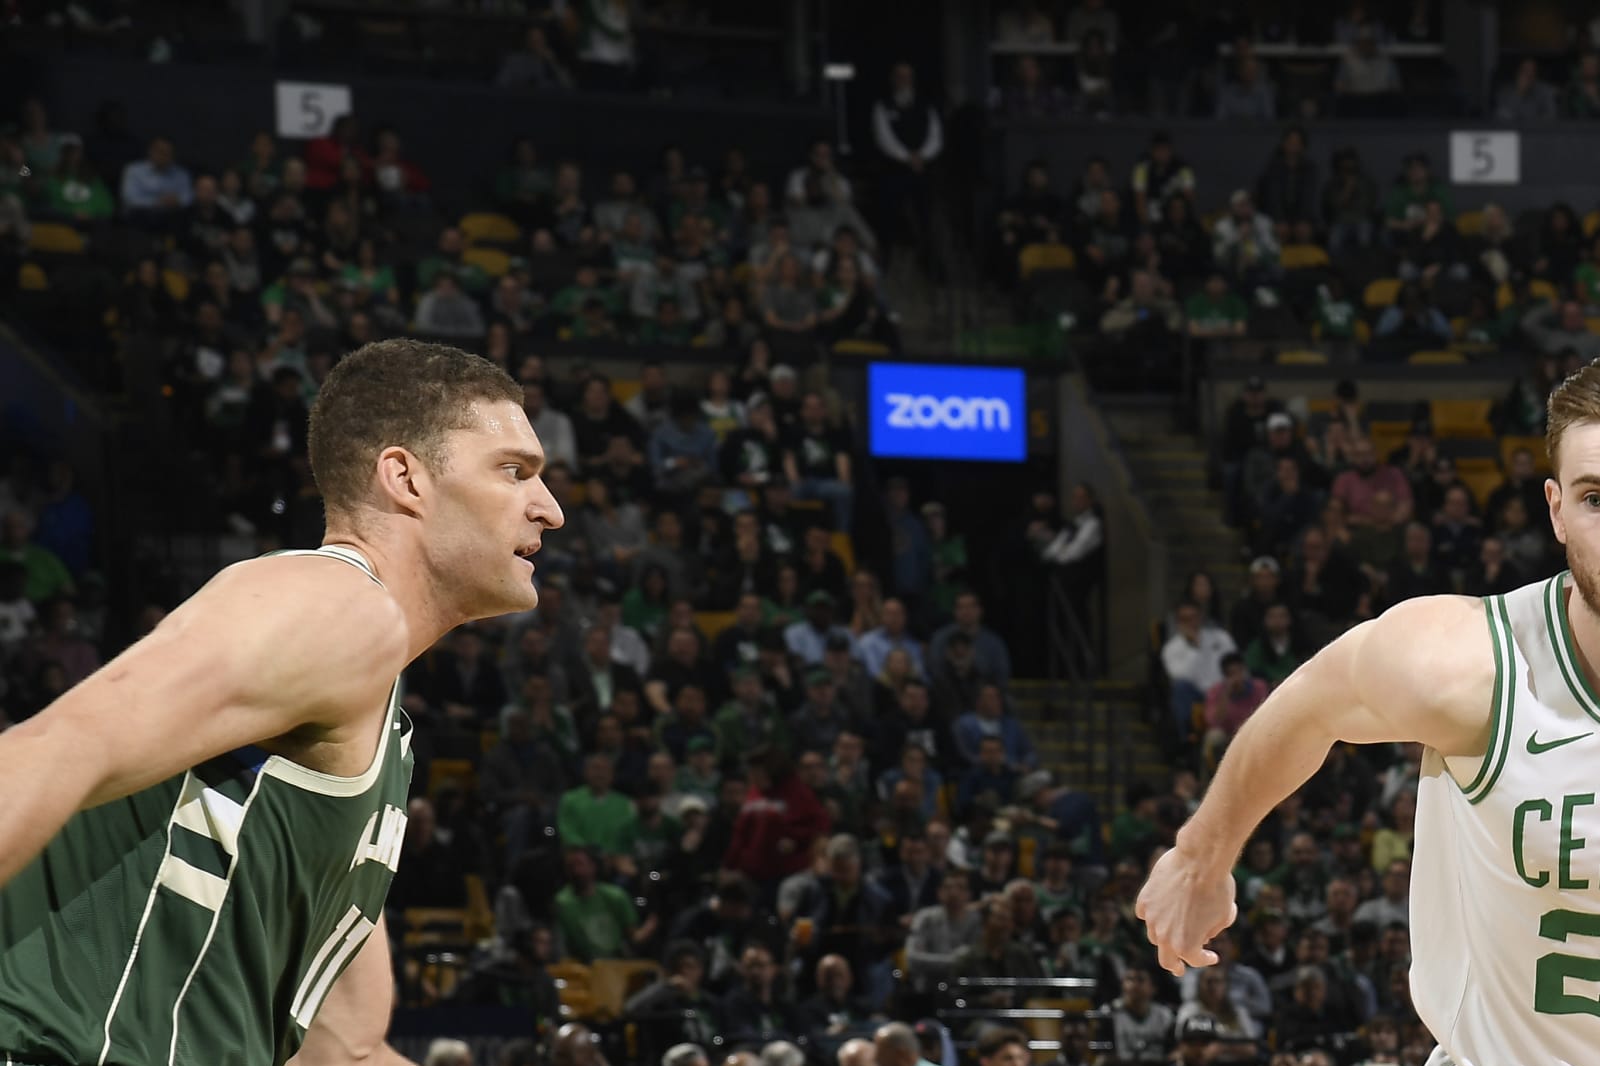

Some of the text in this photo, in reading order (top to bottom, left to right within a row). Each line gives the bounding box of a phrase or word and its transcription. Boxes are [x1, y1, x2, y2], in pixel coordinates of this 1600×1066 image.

[300, 92, 325, 131] 5
[1473, 137, 1496, 177] 5
[885, 392, 1011, 432] zoom
